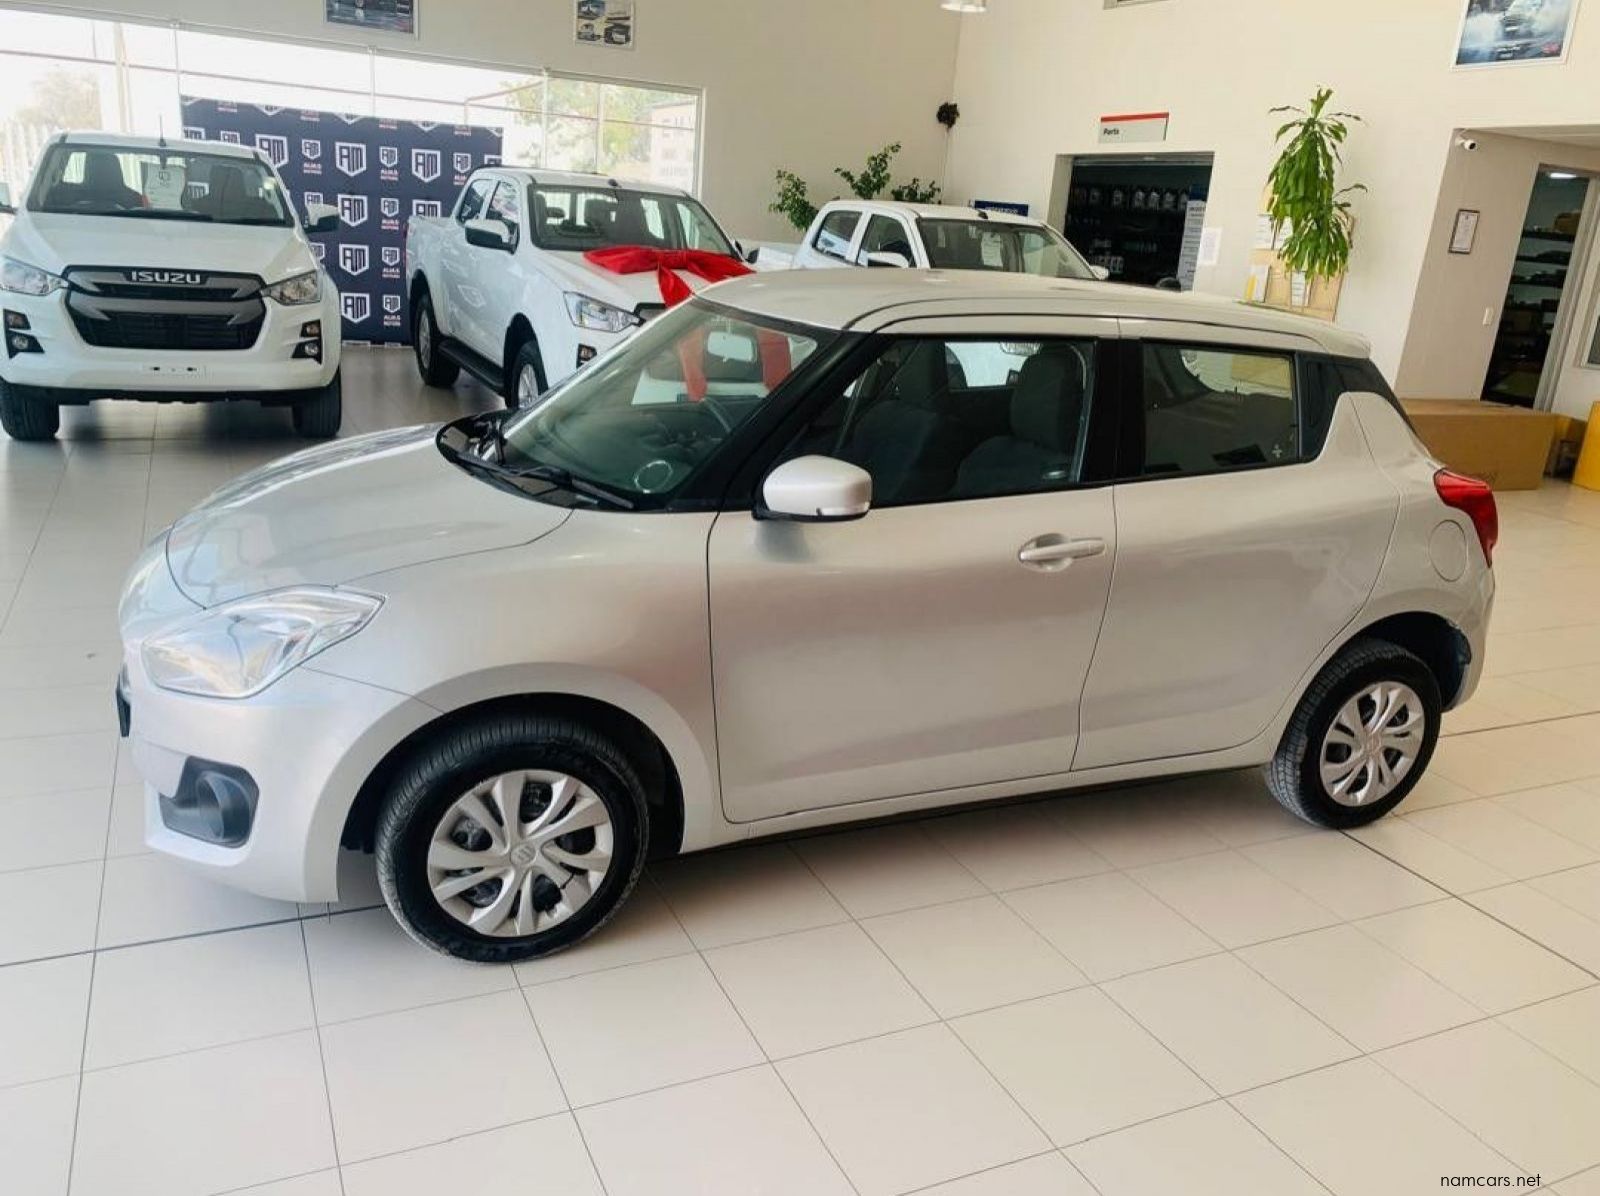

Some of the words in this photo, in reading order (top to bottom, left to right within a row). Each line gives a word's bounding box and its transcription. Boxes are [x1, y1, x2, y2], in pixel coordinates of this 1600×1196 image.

[1103, 127, 1120, 135] Parts
[338, 144, 365, 174] AM
[414, 151, 438, 180] AM
[340, 197, 365, 224] AM
[341, 247, 367, 273] AM
[131, 270, 200, 284] ISUZU
[343, 295, 368, 321] AM
